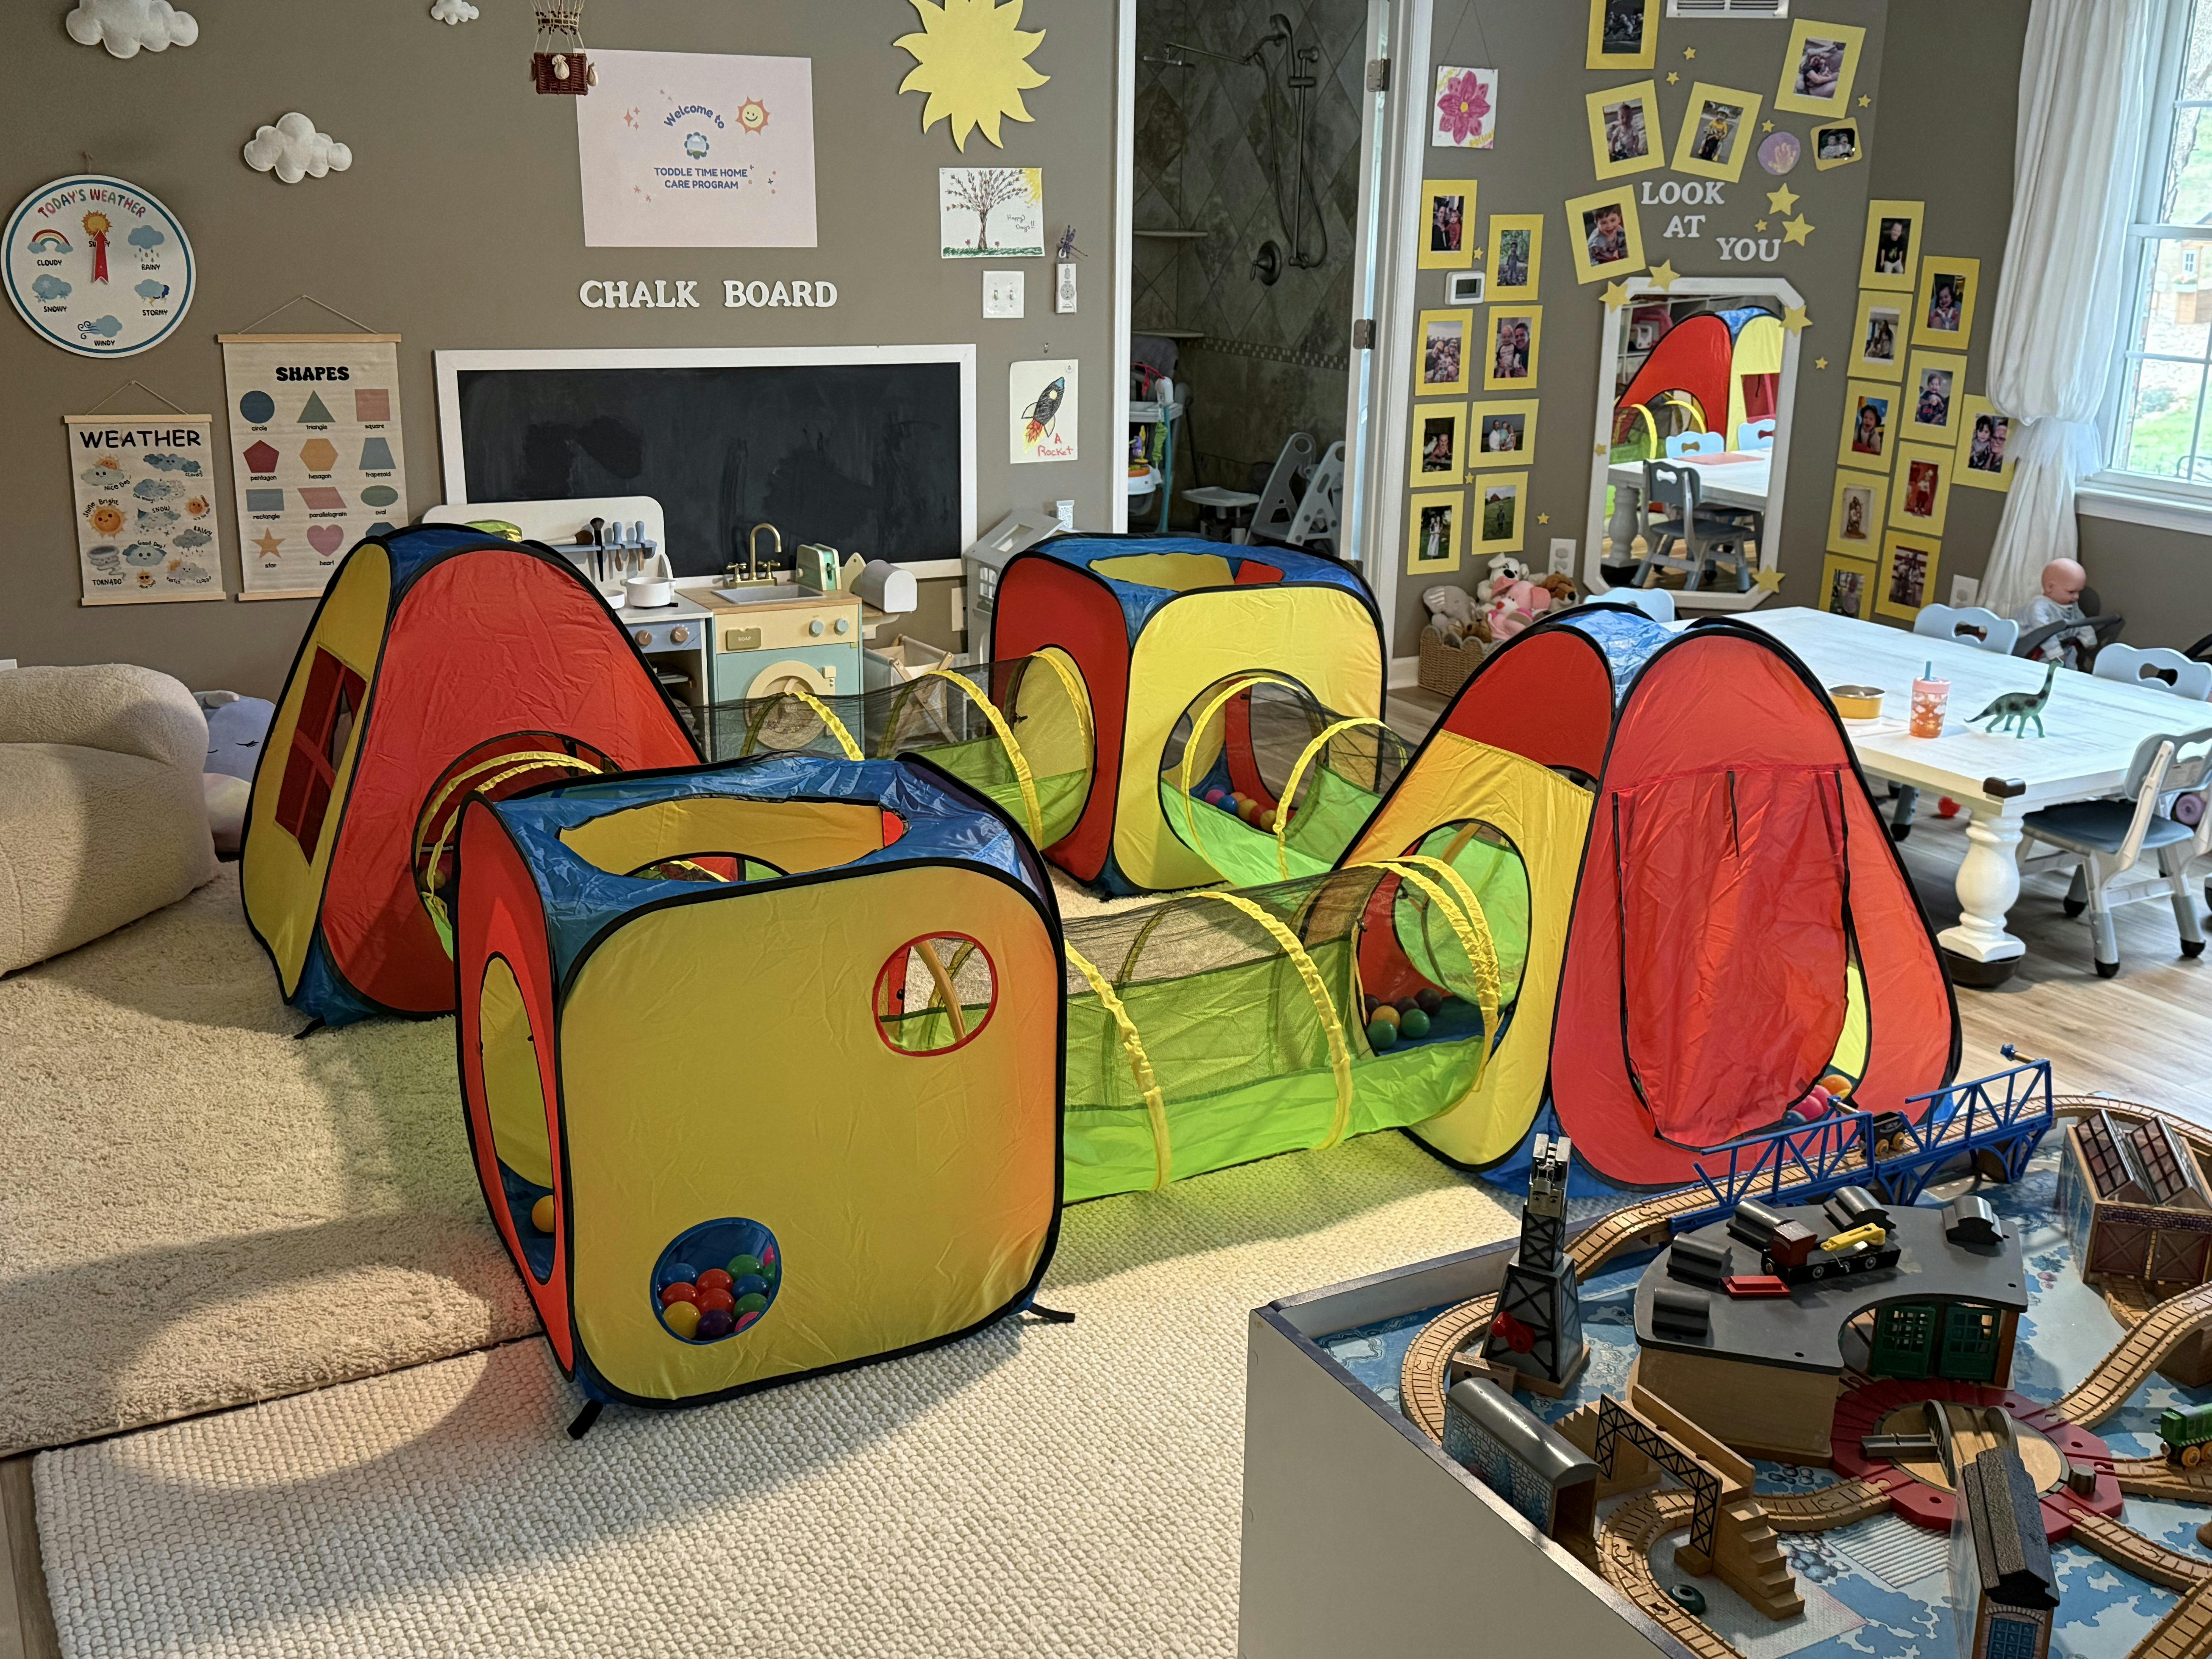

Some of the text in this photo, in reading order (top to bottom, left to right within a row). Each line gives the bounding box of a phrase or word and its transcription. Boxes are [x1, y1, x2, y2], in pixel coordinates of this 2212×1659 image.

[664, 105, 725, 129] Welcome to
[654, 167, 748, 177] TODDLE TIME HOME
[665, 180, 738, 189] CARE PROGRAM
[1641, 181, 1725, 205] LOOK
[38, 189, 146, 218] TODAY'S WEATHER
[1007, 214, 1025, 223] Happy
[1663, 215, 1706, 238] AT
[1716, 237, 1781, 262] YOU
[580, 280, 838, 308] CHALK BOARD
[276, 366, 350, 381] SHAPES
[79, 429, 201, 448] WEATHER
[1054, 433, 1062, 444] A
